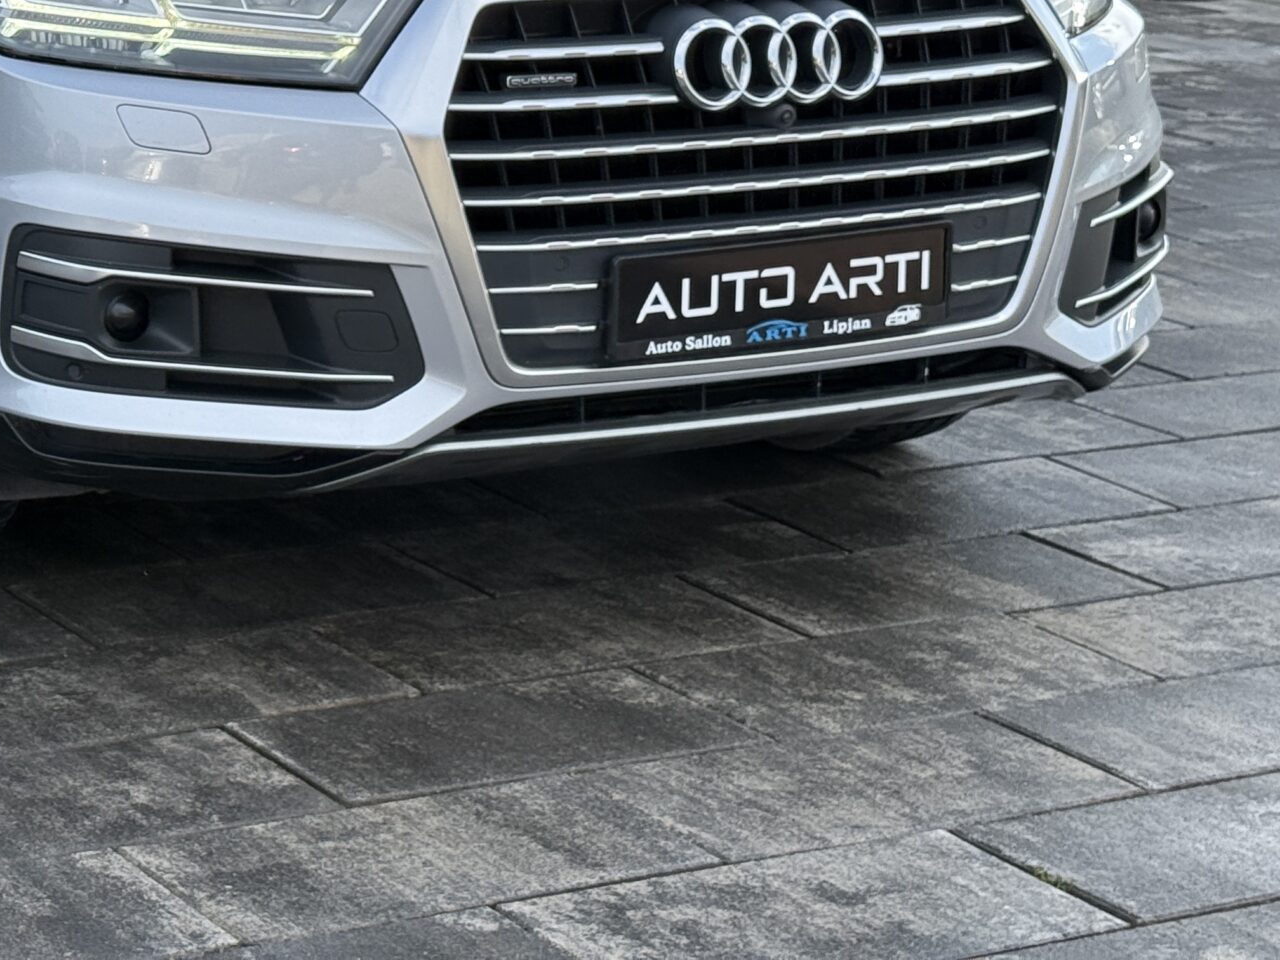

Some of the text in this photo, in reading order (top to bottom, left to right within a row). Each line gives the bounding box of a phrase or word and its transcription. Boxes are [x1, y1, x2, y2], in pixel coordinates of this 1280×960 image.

[510, 74, 575, 87] quattro
[635, 249, 931, 324] AUTO ARTI
[645, 317, 872, 356] Auto Sallon ARTI Lipjan
